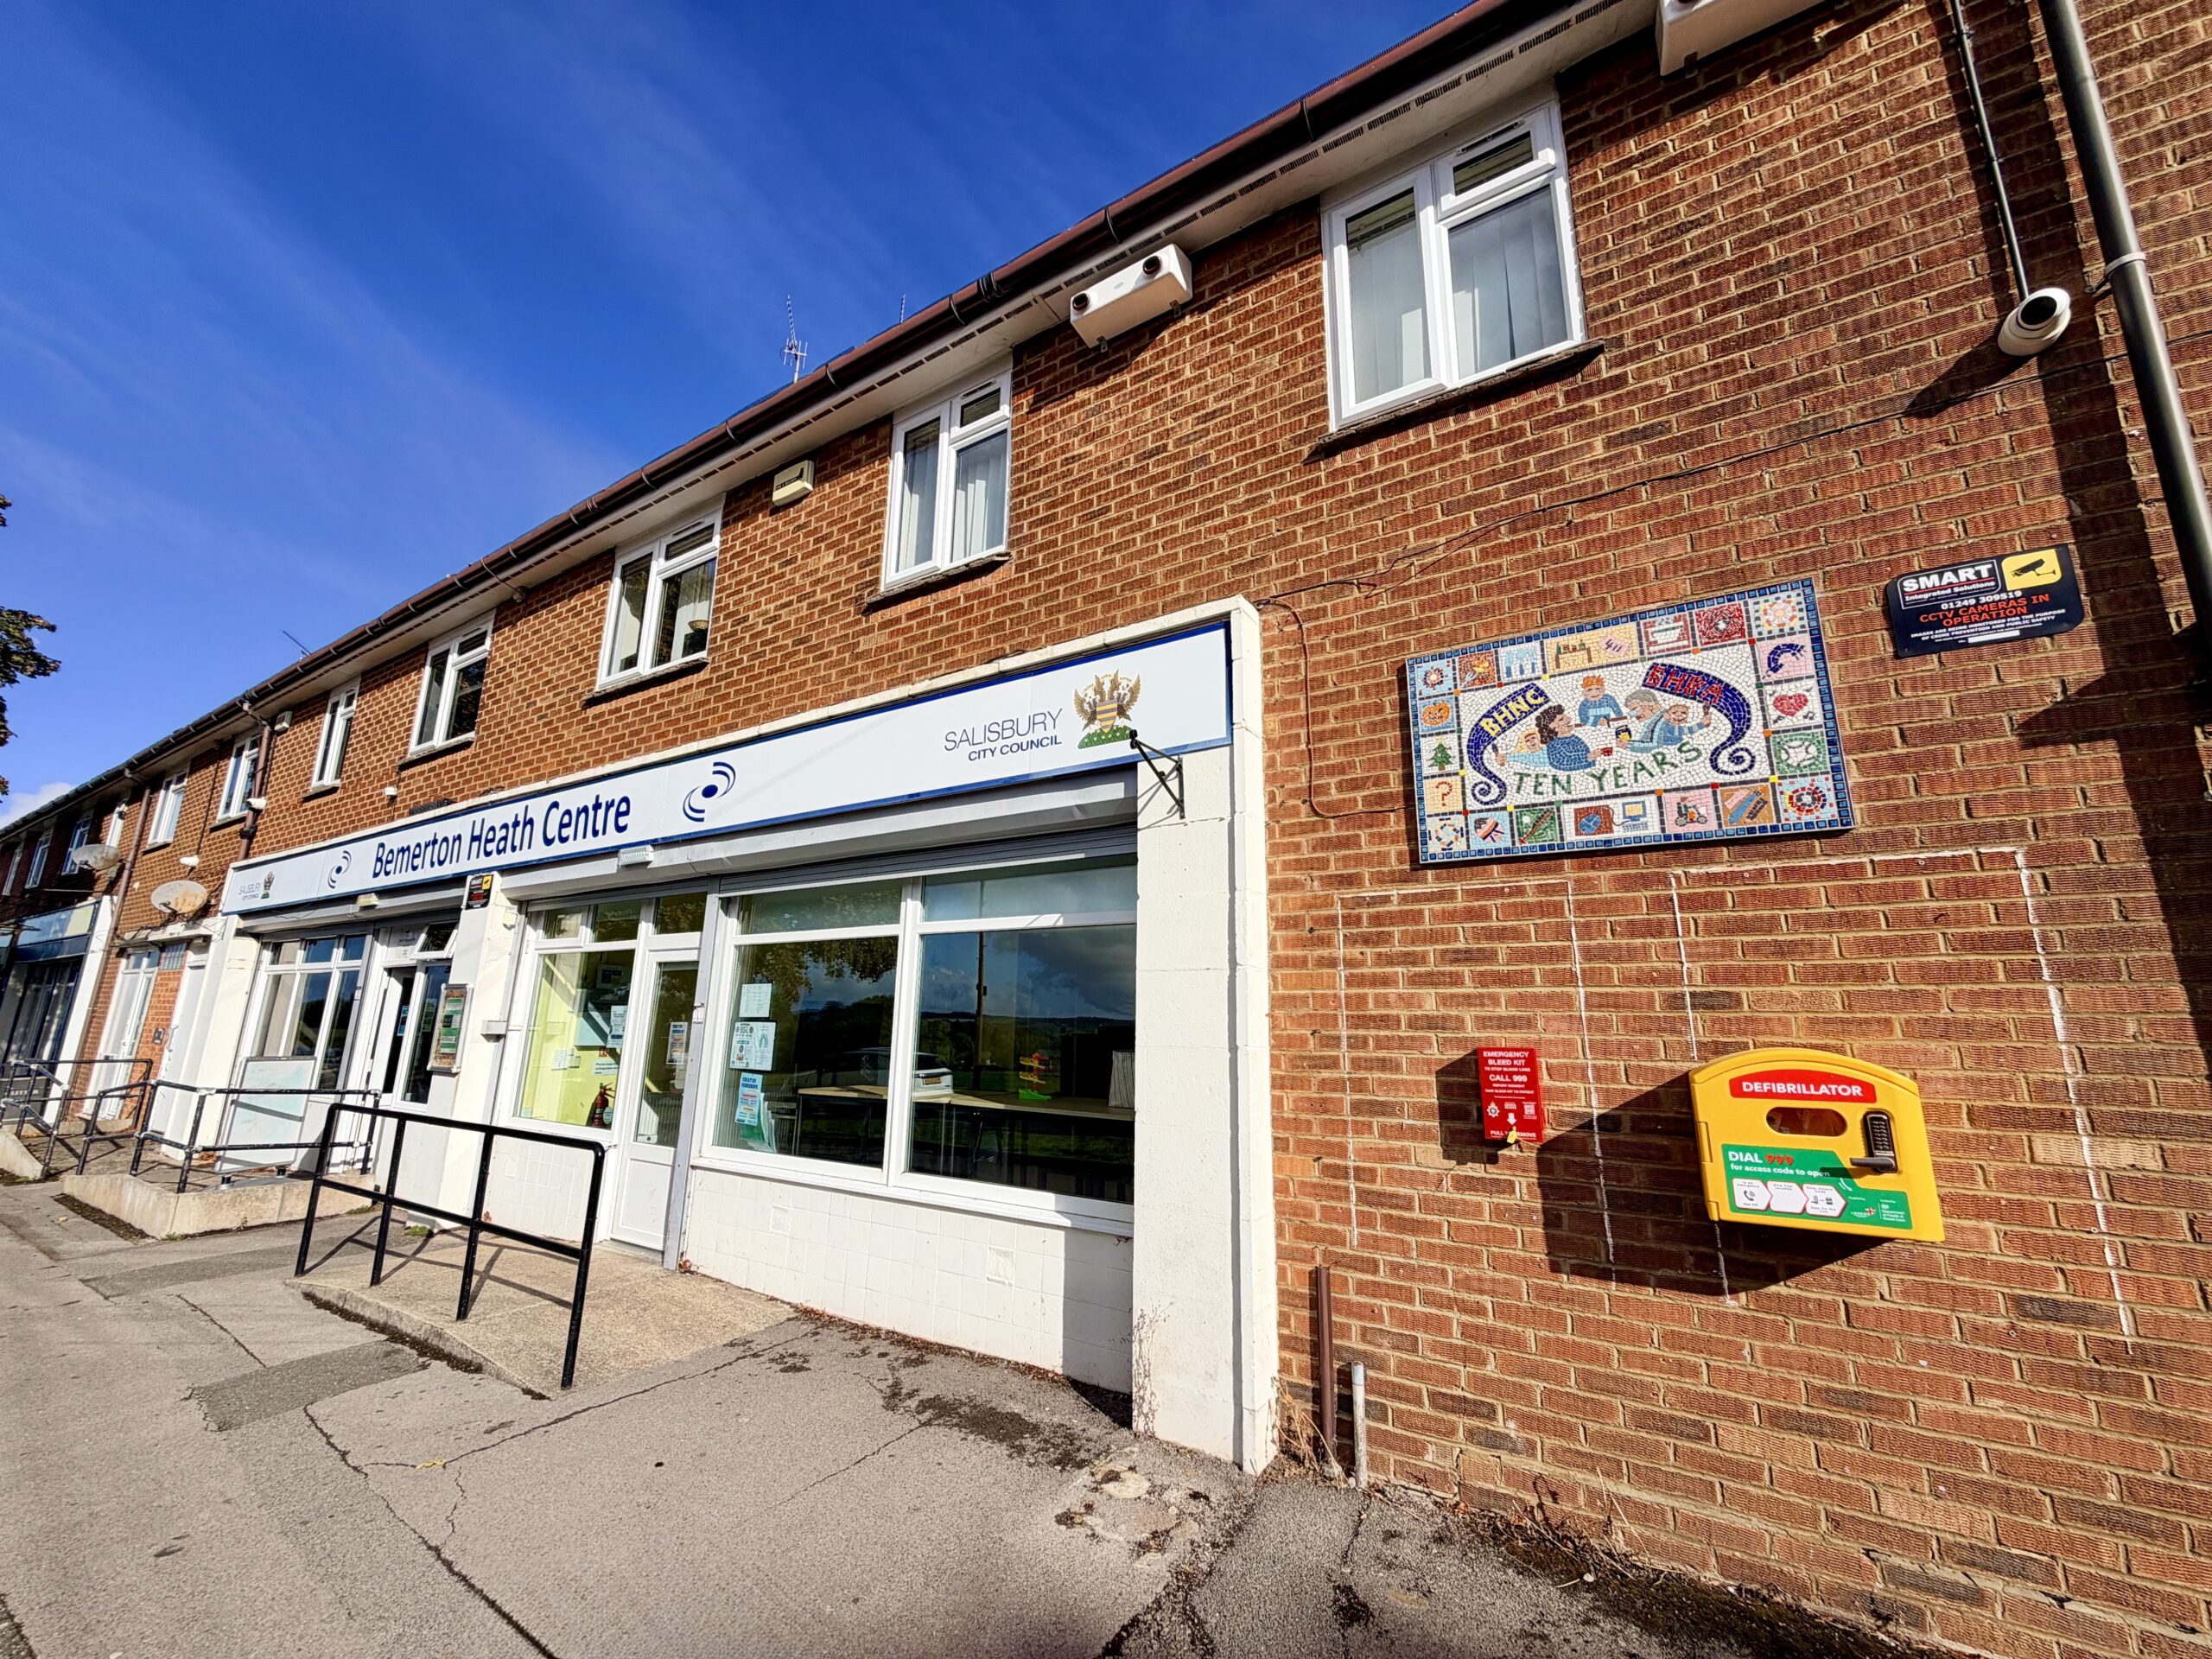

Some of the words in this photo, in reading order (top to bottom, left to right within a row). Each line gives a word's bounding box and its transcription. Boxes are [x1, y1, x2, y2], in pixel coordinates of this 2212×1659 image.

[1903, 564, 1993, 592] SMART
[1905, 588, 1951, 601] Integrated
[1953, 581, 1995, 593] Solutions
[1920, 610, 1954, 622] CCTV
[1959, 598, 2027, 615] CAMERAS
[2031, 594, 2050, 604] IN
[1941, 598, 1976, 610] 01249
[1979, 590, 2022, 603] 309519
[2035, 608, 2066, 617] PURPOSE
[1942, 607, 2027, 626] OPERATION
[1479, 689, 1546, 736] BHNC
[944, 708, 1062, 751] SALISBURY
[969, 747, 997, 761] CITY
[1000, 734, 1062, 755] COUNCIL
[1513, 771, 1572, 795] TEN
[1588, 741, 1702, 792] YEARS
[372, 830, 462, 879] Bemerton
[467, 804, 535, 861] Heath
[542, 794, 631, 847] Centre
[1742, 1082, 1863, 1096] DEFIBRILLATOR
[1728, 1151, 1763, 1163] DIAL
[1765, 1154, 1794, 1166] 999
